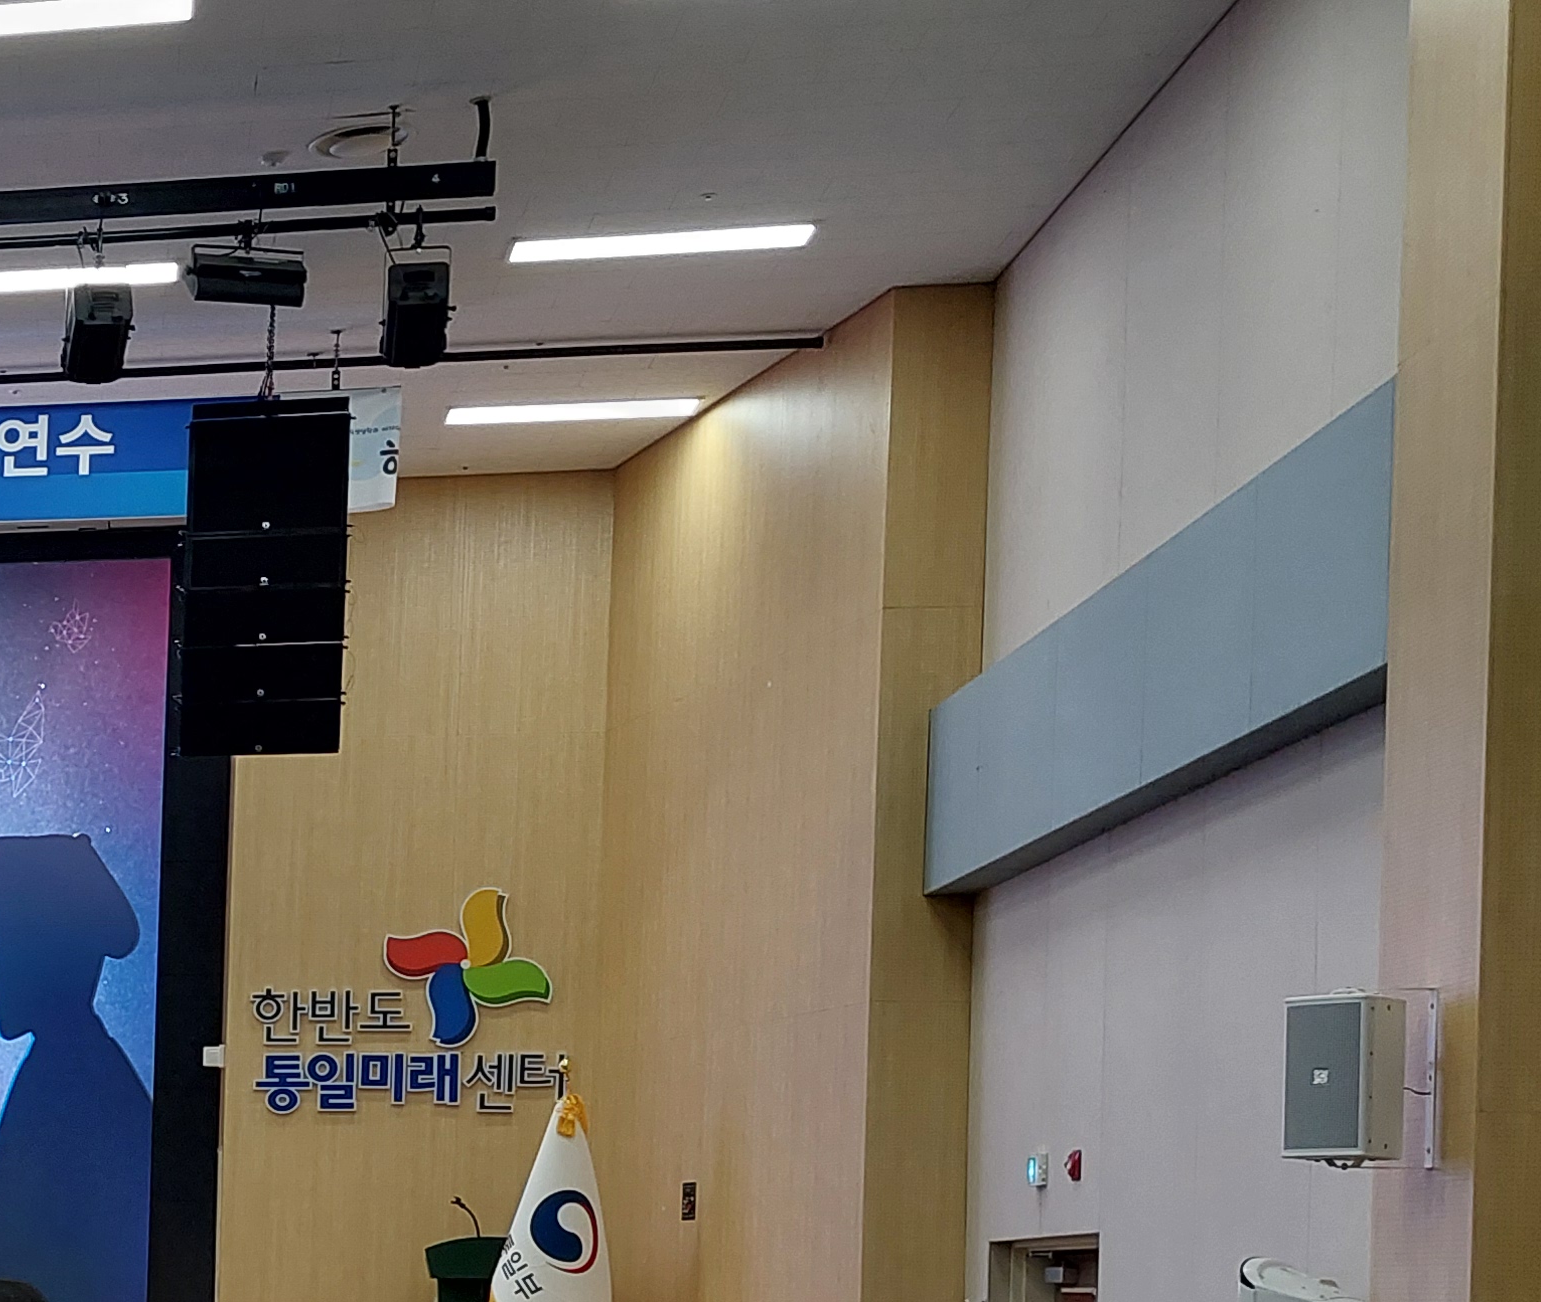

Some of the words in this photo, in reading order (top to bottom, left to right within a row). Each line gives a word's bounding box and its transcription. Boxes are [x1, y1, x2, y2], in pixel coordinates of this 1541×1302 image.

[117, 193, 129, 205] 3
[251, 987, 412, 1045] 한반도
[253, 1051, 569, 1114] 통일미래센터
